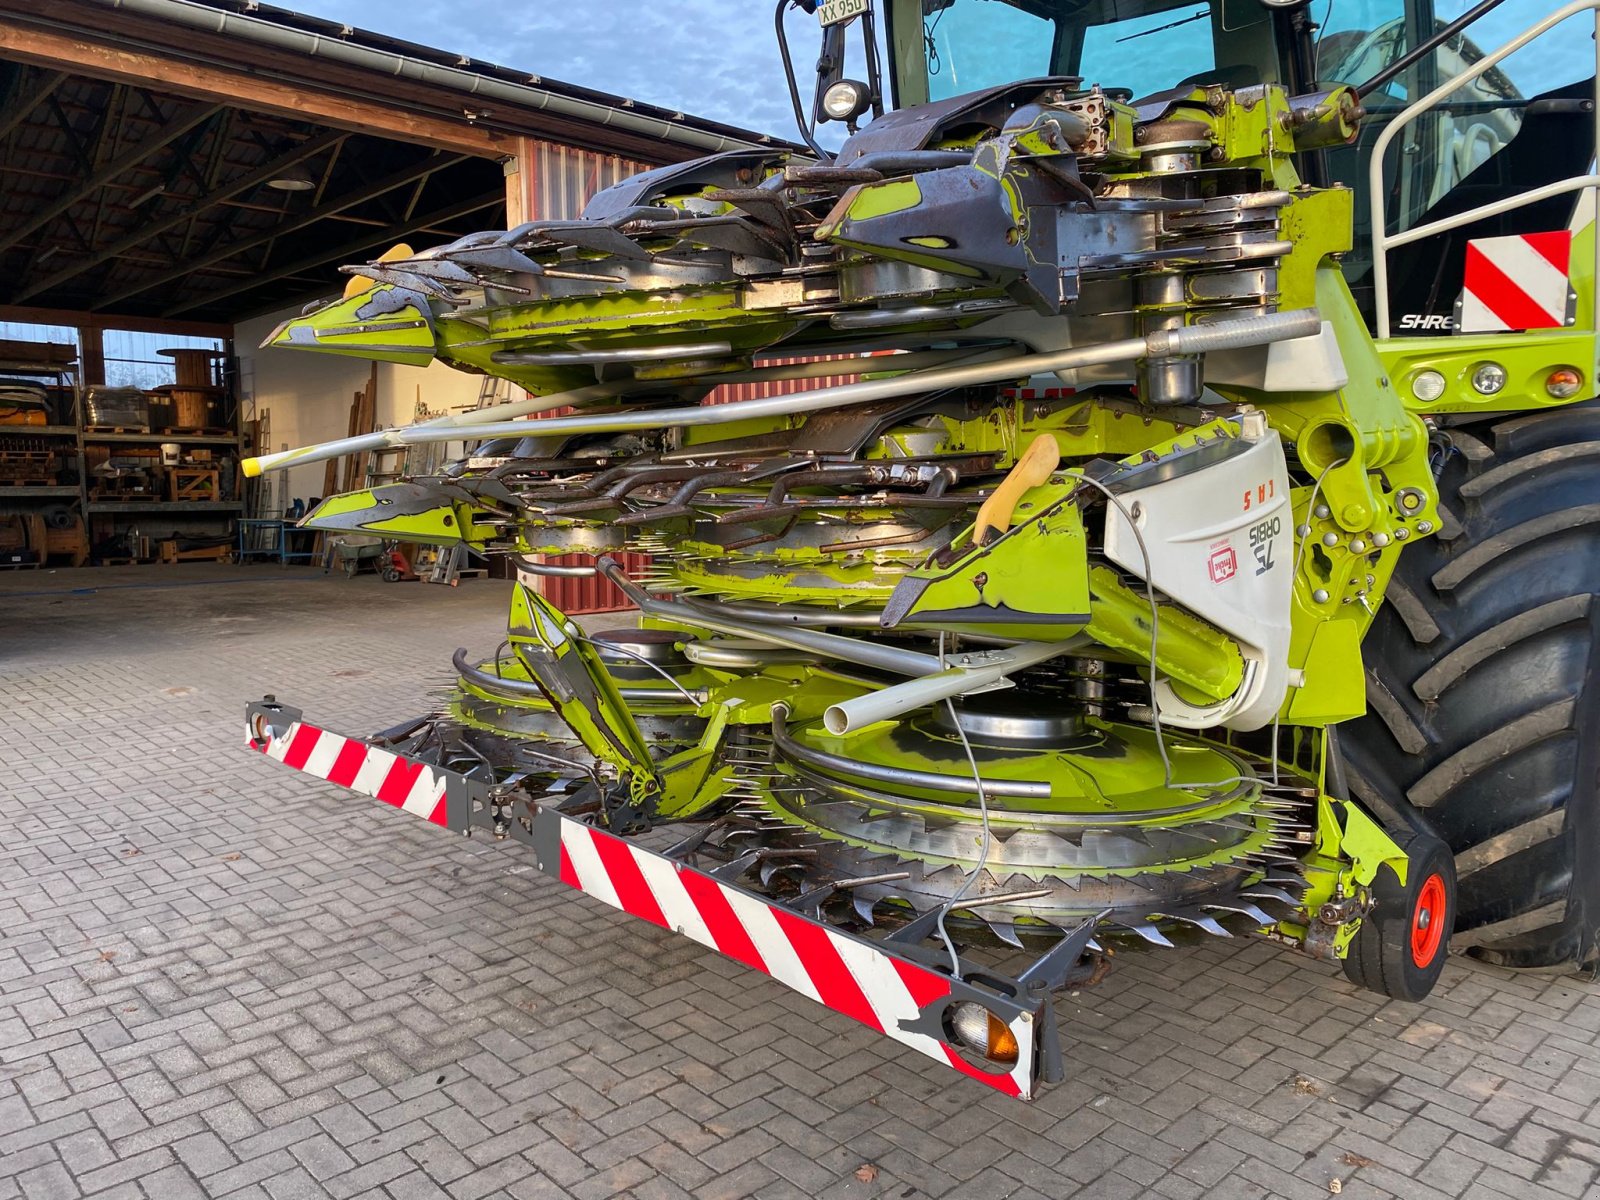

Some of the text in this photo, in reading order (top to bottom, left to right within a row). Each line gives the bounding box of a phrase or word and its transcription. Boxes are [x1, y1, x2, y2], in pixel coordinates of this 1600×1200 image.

[821, 5, 838, 23] XX
[1250, 516, 1281, 547] ORBIS
[1254, 540, 1275, 577] 75
